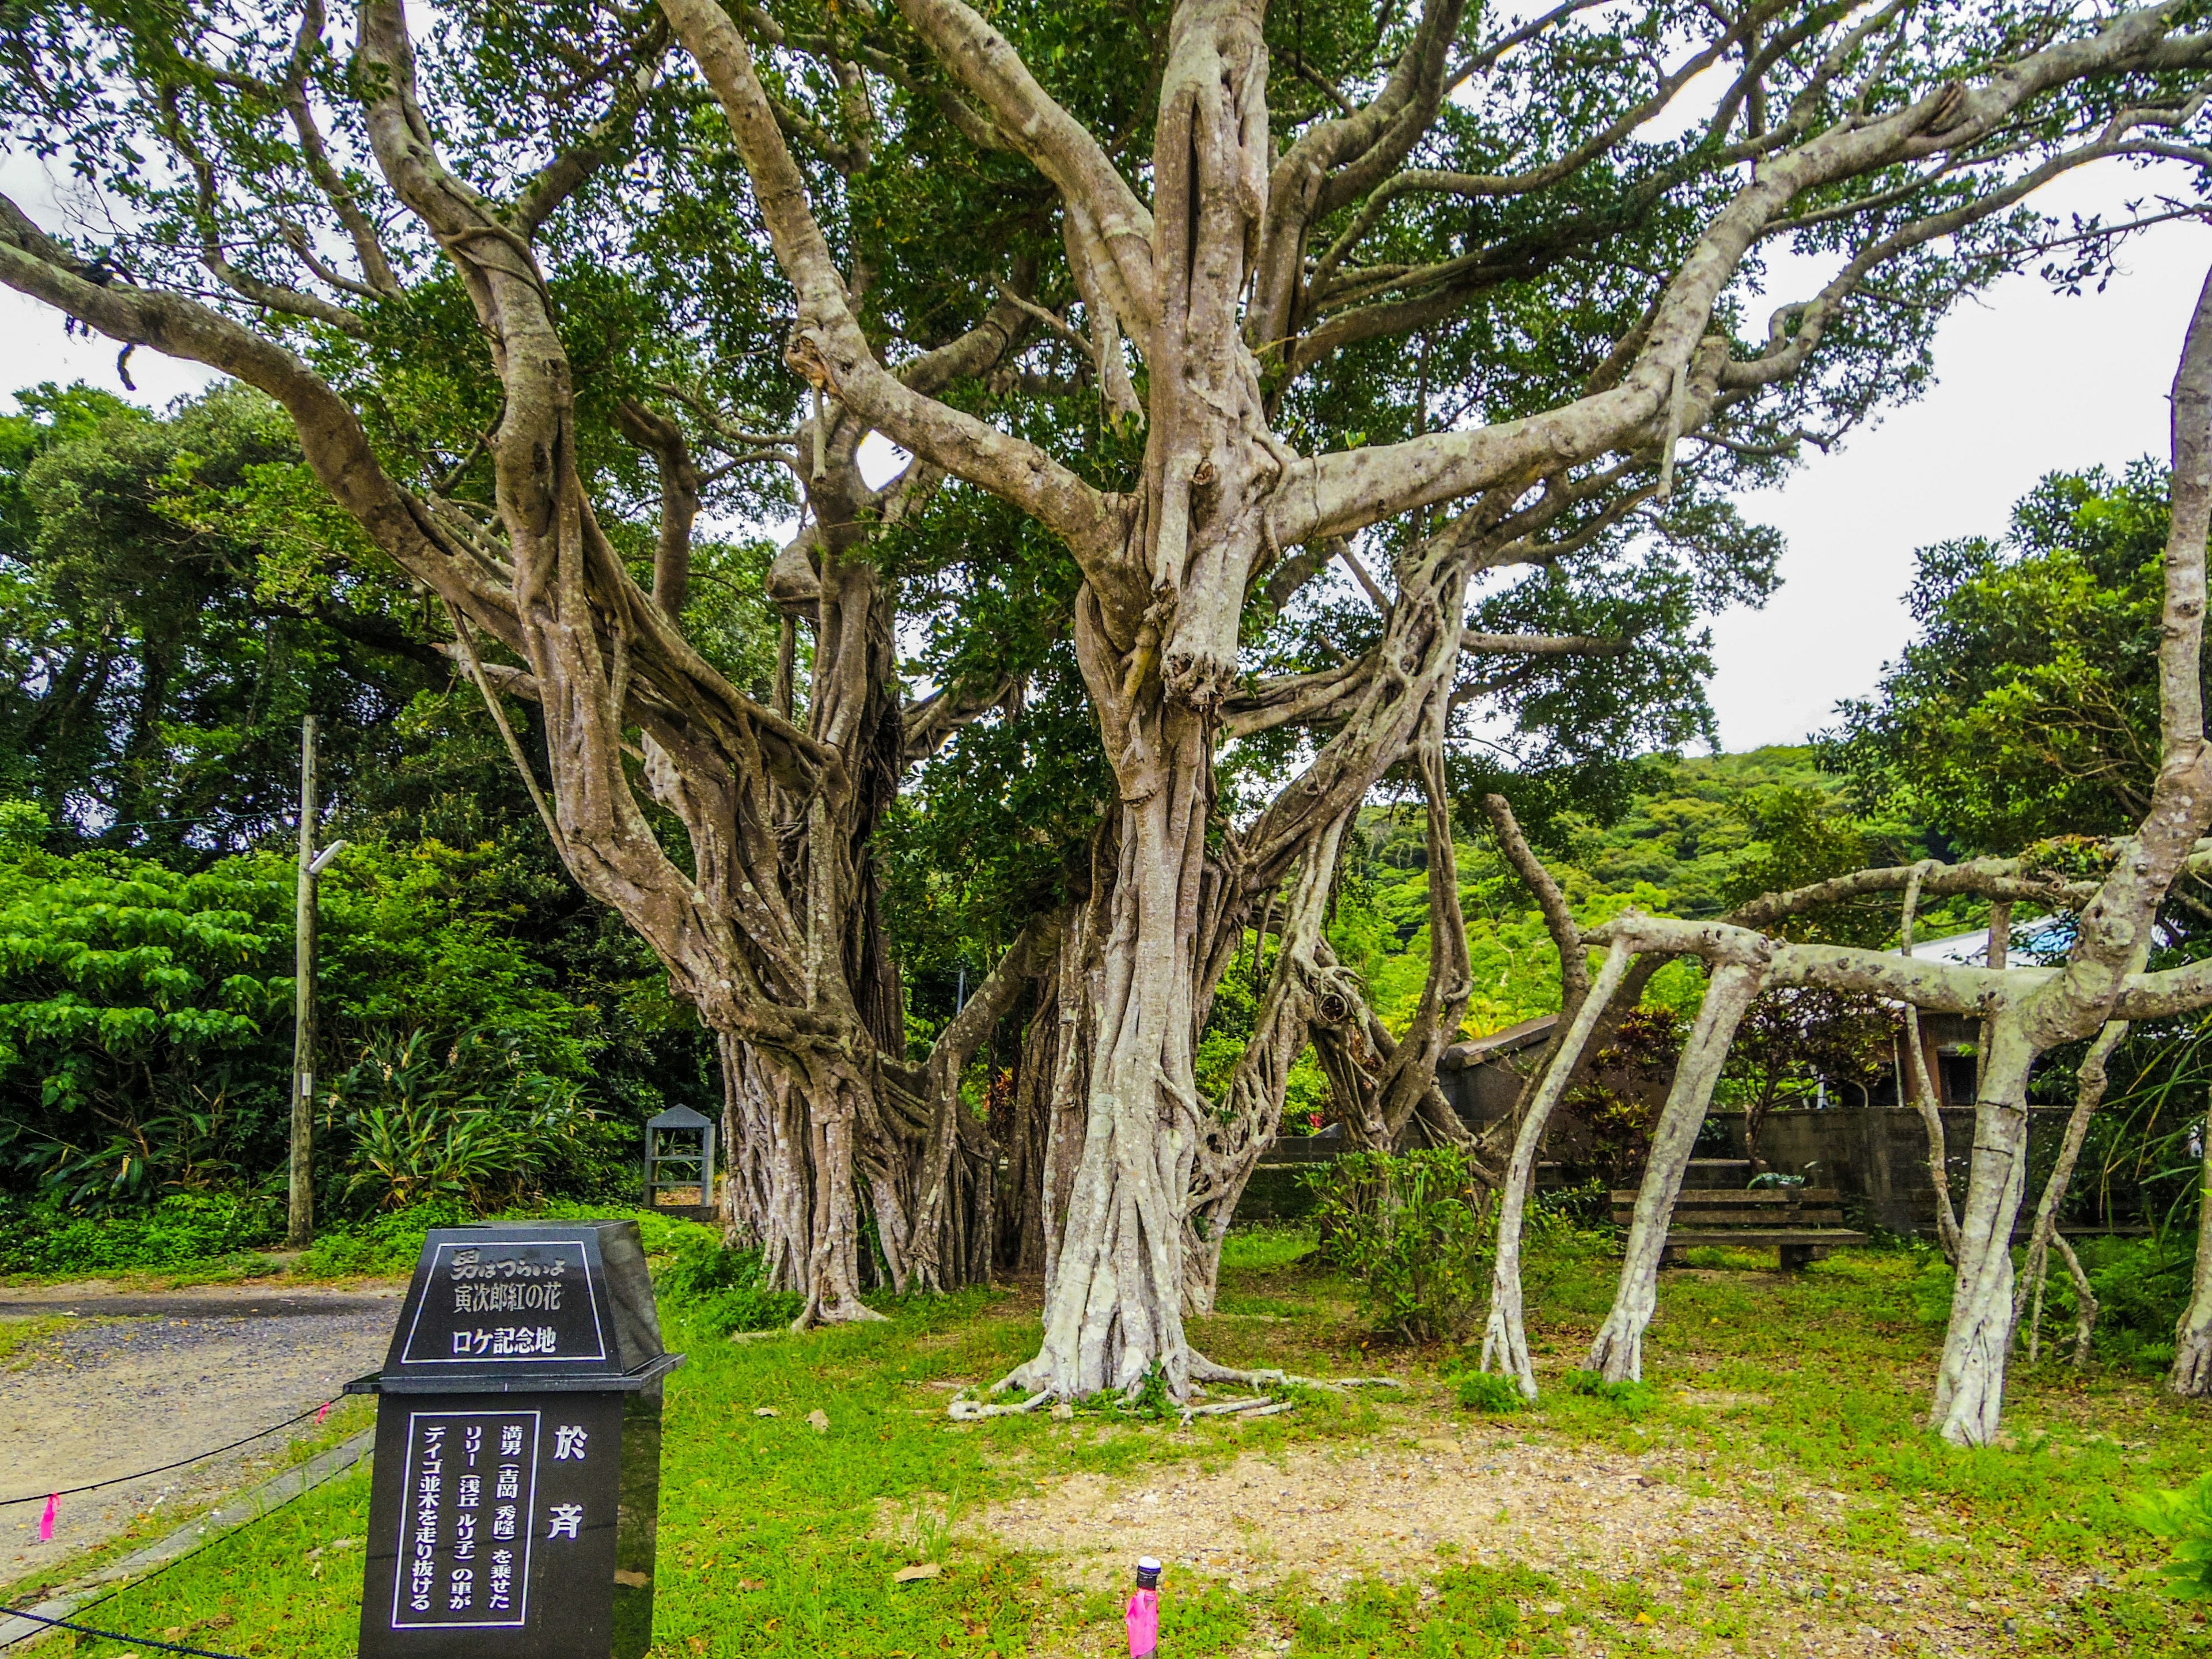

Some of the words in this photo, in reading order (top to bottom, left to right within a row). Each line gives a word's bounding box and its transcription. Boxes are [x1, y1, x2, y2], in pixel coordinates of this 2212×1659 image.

[450, 1247, 565, 1280] 男はつらいよ
[454, 1282, 562, 1313] 寅次郎紅の花
[453, 1327, 556, 1354] ロケ記念地
